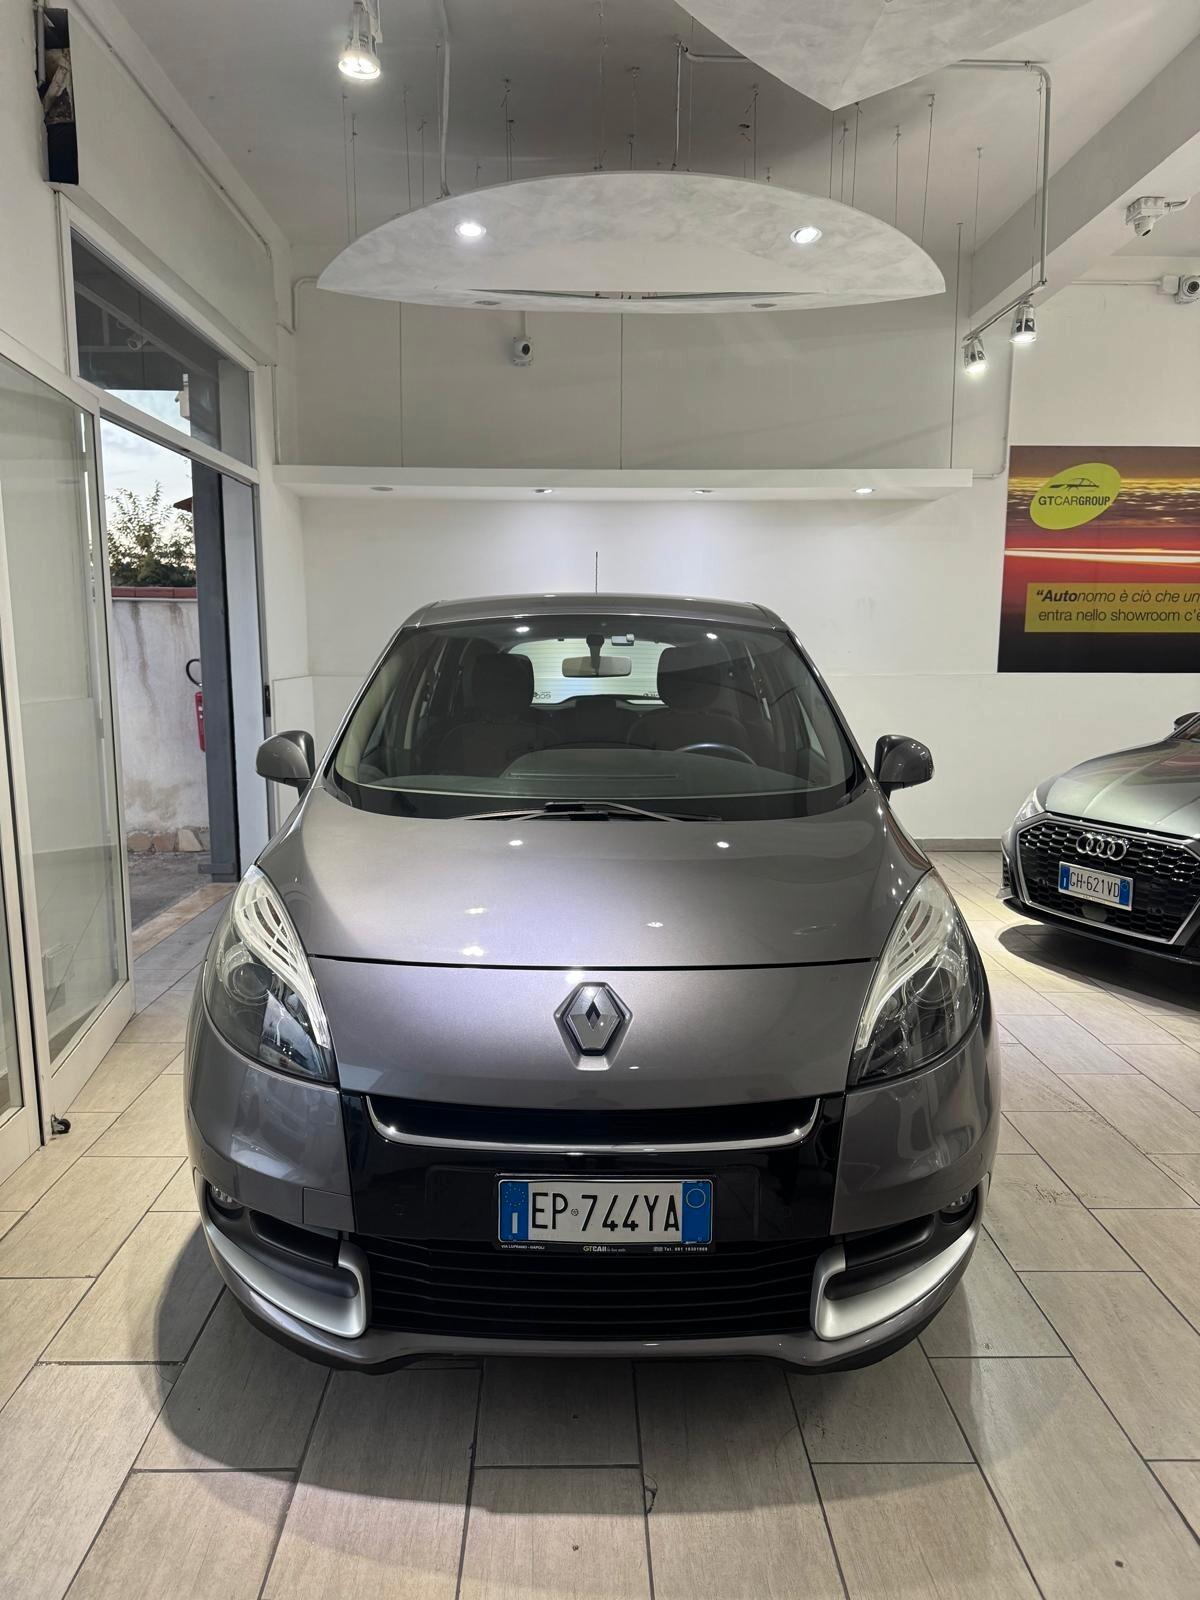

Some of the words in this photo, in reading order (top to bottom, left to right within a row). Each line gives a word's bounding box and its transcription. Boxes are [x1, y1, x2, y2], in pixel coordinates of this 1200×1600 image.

[1039, 496, 1110, 505] GTCARGROUP
[1119, 590, 1128, 602] è
[1132, 590, 1151, 602] ciò
[1155, 590, 1179, 602] che
[1039, 610, 1072, 621] entra
[1076, 609, 1107, 621] nello
[1110, 609, 1180, 621] showroom
